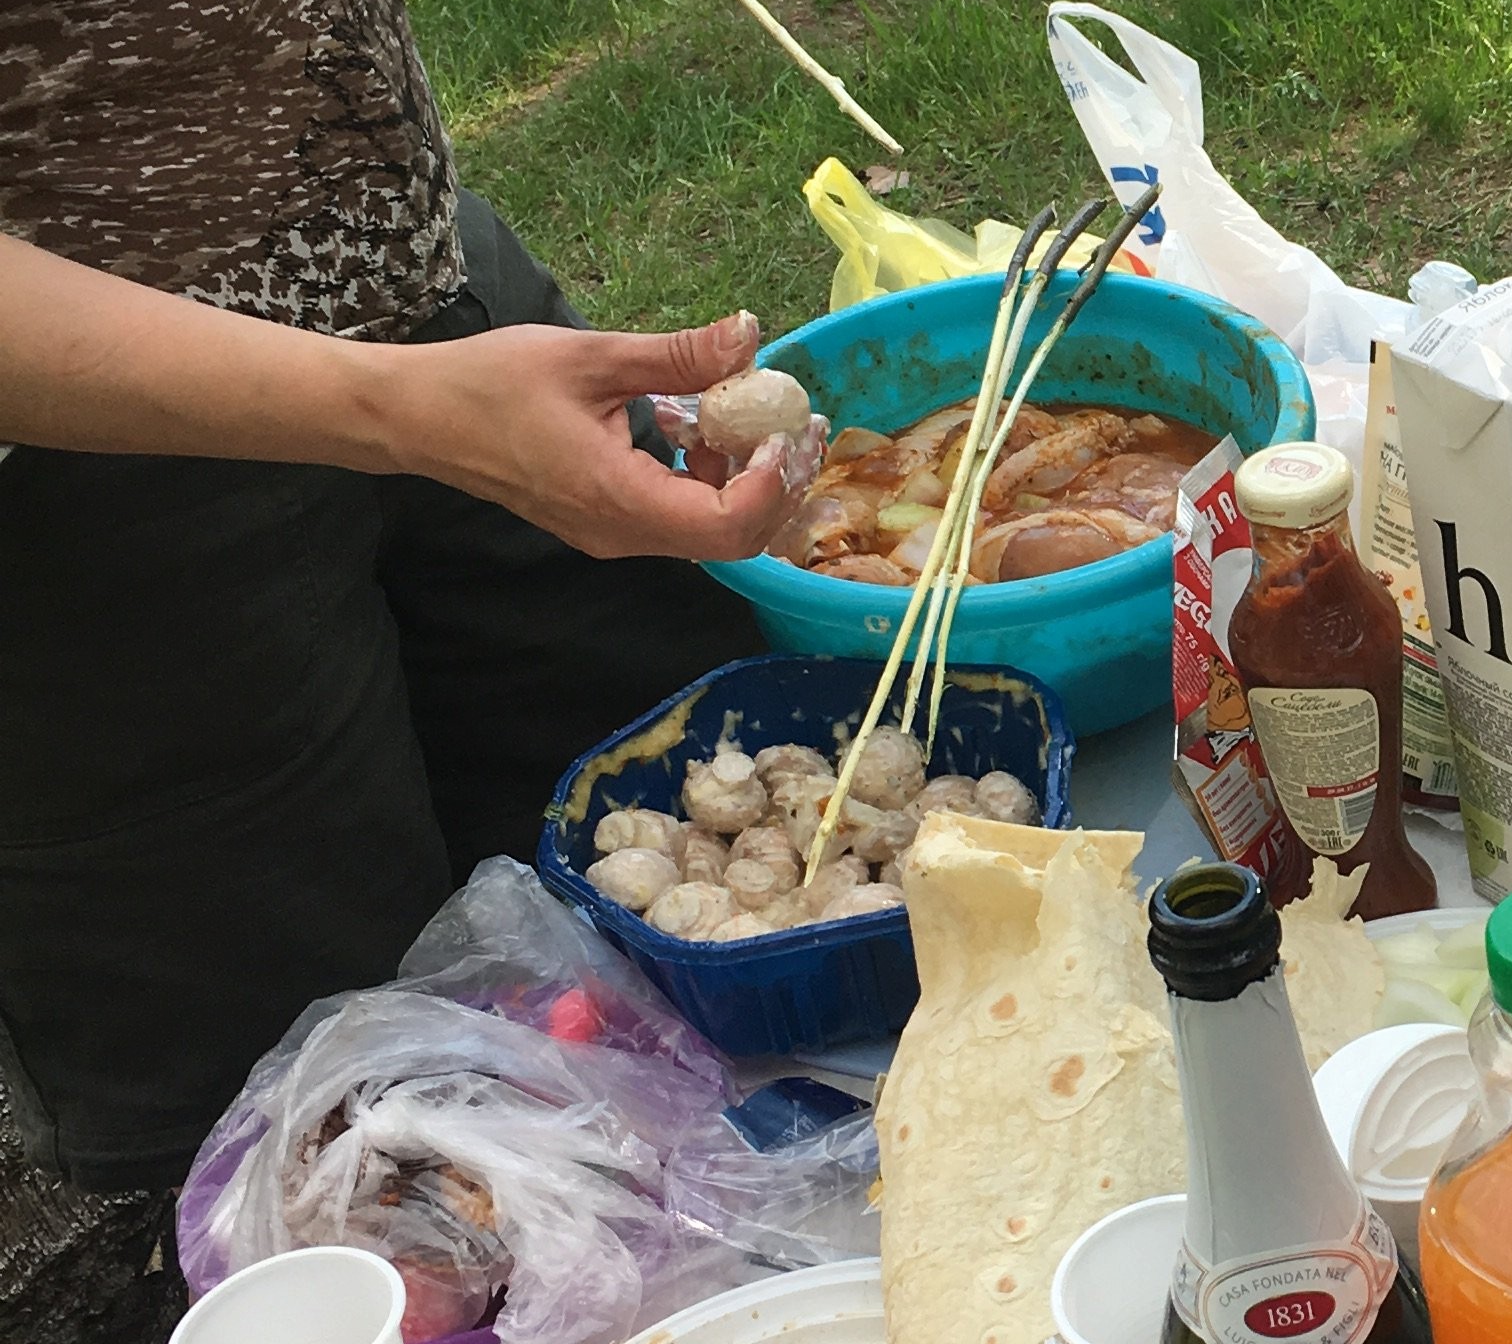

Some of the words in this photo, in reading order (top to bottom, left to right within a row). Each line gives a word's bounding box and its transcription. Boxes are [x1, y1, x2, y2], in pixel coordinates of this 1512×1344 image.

[1219, 1282, 1250, 1308] CASA
[1252, 1267, 1321, 1292] FONDATA
[1325, 1266, 1348, 1283] NEL
[1266, 1300, 1317, 1329] 1831
[1333, 1301, 1361, 1337] FIGLI
